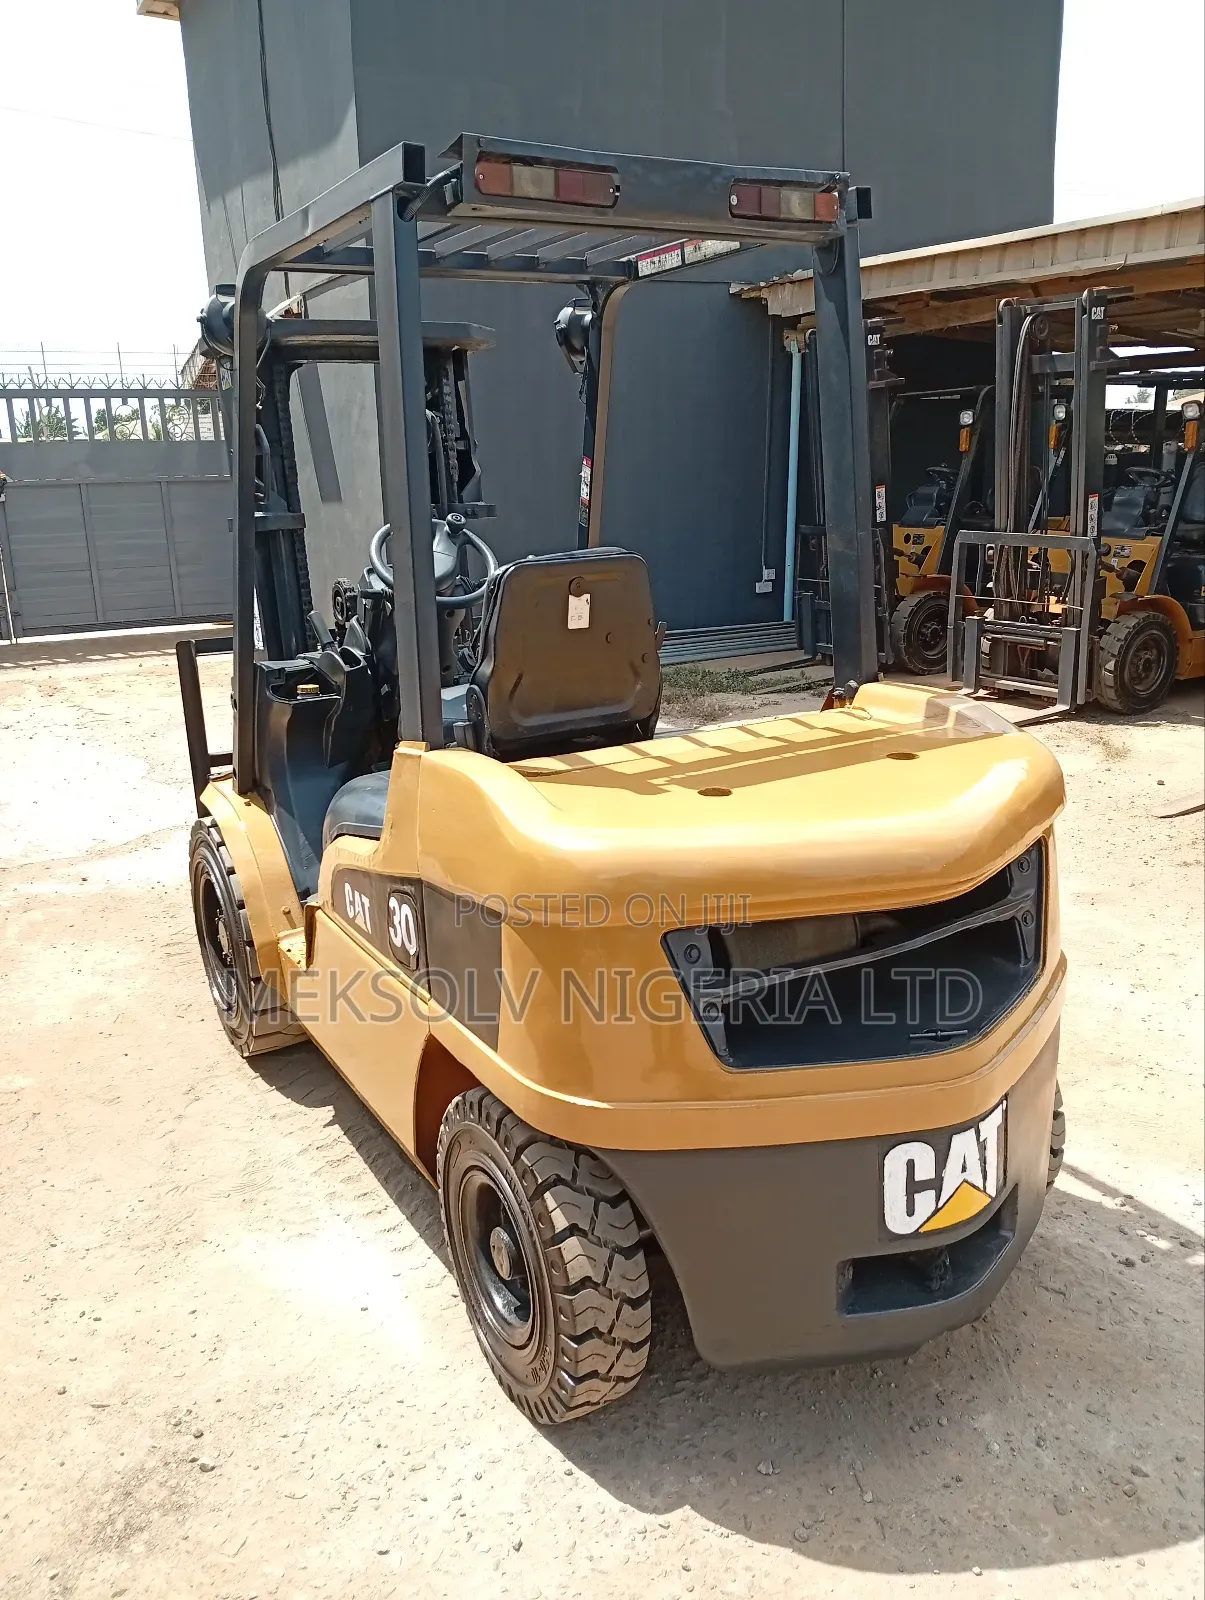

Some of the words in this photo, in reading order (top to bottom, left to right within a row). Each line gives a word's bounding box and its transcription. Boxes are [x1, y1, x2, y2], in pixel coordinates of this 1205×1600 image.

[1091, 306, 1105, 319] CAT
[867, 334, 881, 345] CAT
[344, 882, 372, 935] CAT
[388, 896, 417, 956] 30
[883, 1100, 1007, 1235] CAT
